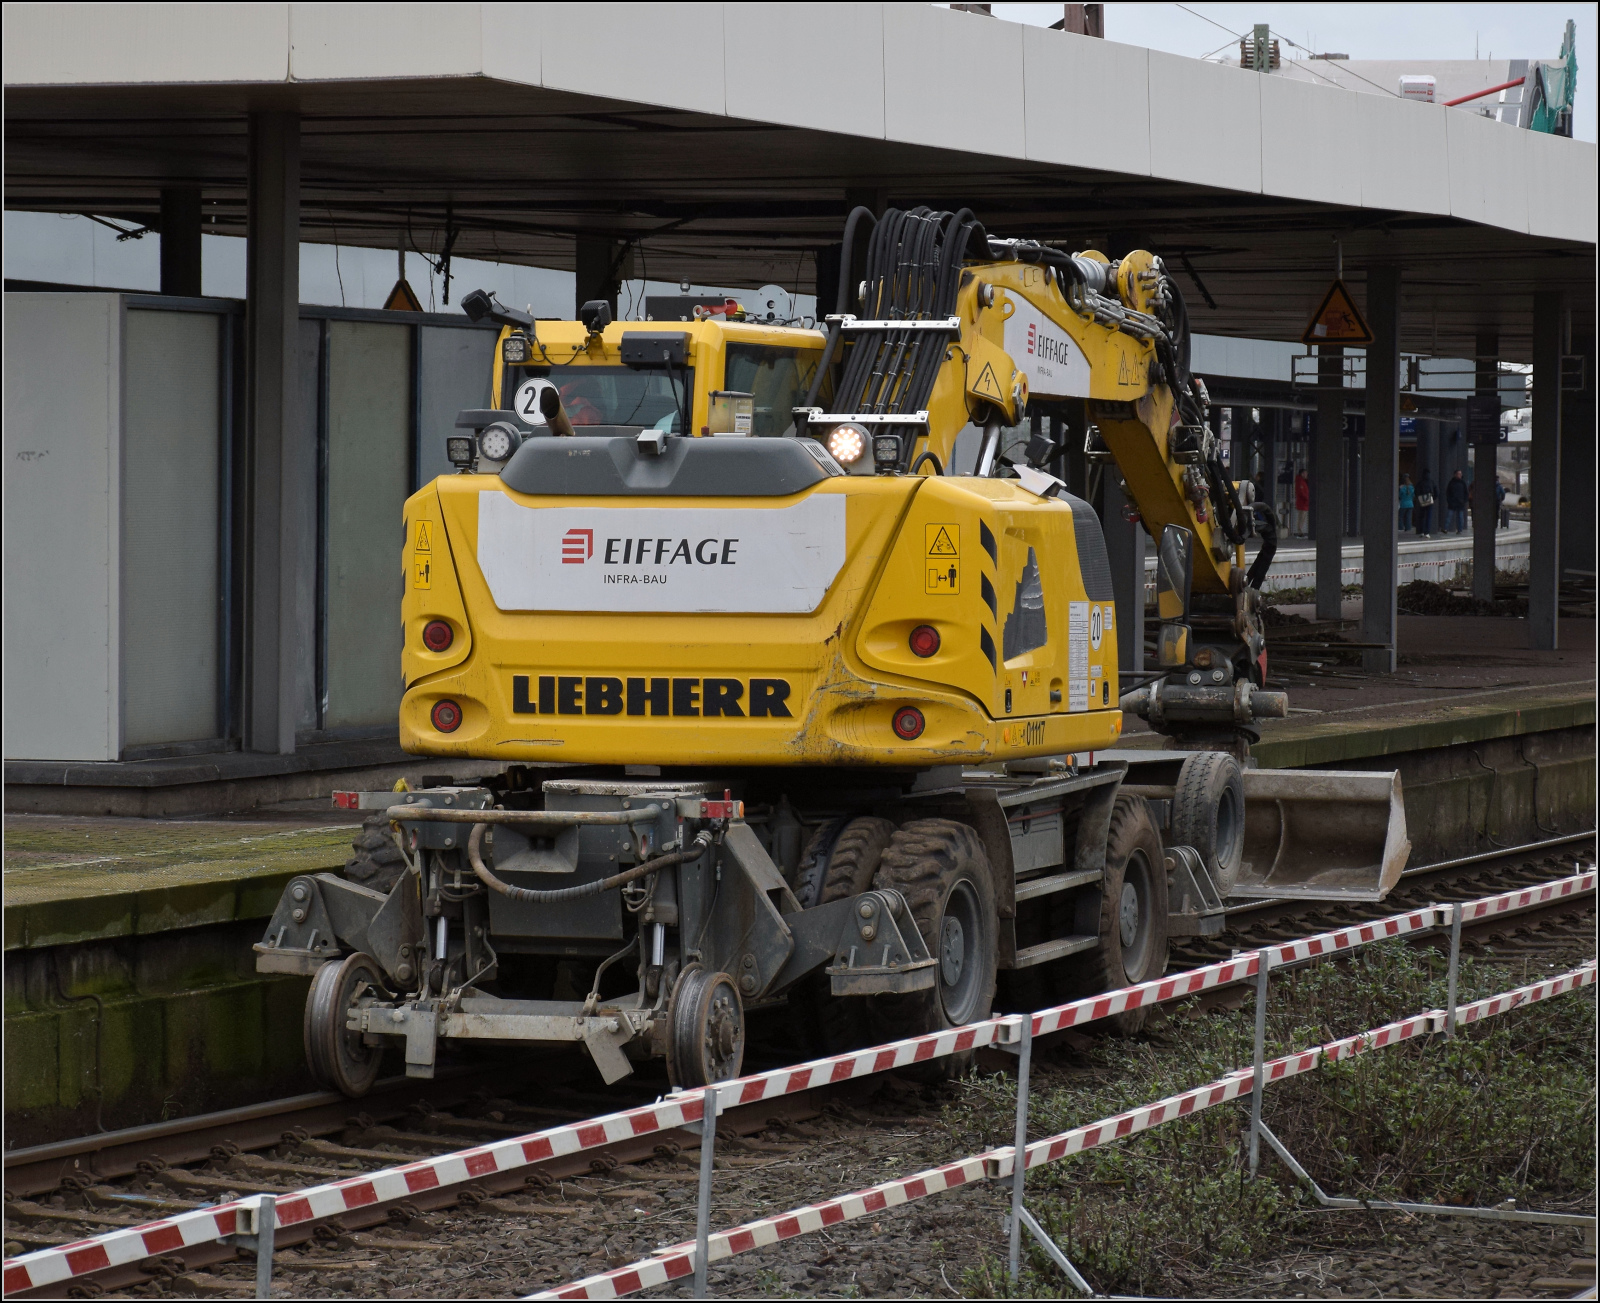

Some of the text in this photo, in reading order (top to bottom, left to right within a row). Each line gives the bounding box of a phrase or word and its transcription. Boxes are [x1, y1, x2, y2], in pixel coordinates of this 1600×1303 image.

[1038, 335, 1068, 366] EIFFAGE
[523, 386, 543, 415] 2
[1223, 450, 1229, 458] F
[604, 538, 740, 565] EIFFAGE
[603, 574, 667, 584] INFRA-BAU
[1092, 612, 1101, 641] 20
[513, 675, 794, 718] LIEBHERR
[1026, 721, 1045, 746] 01117
